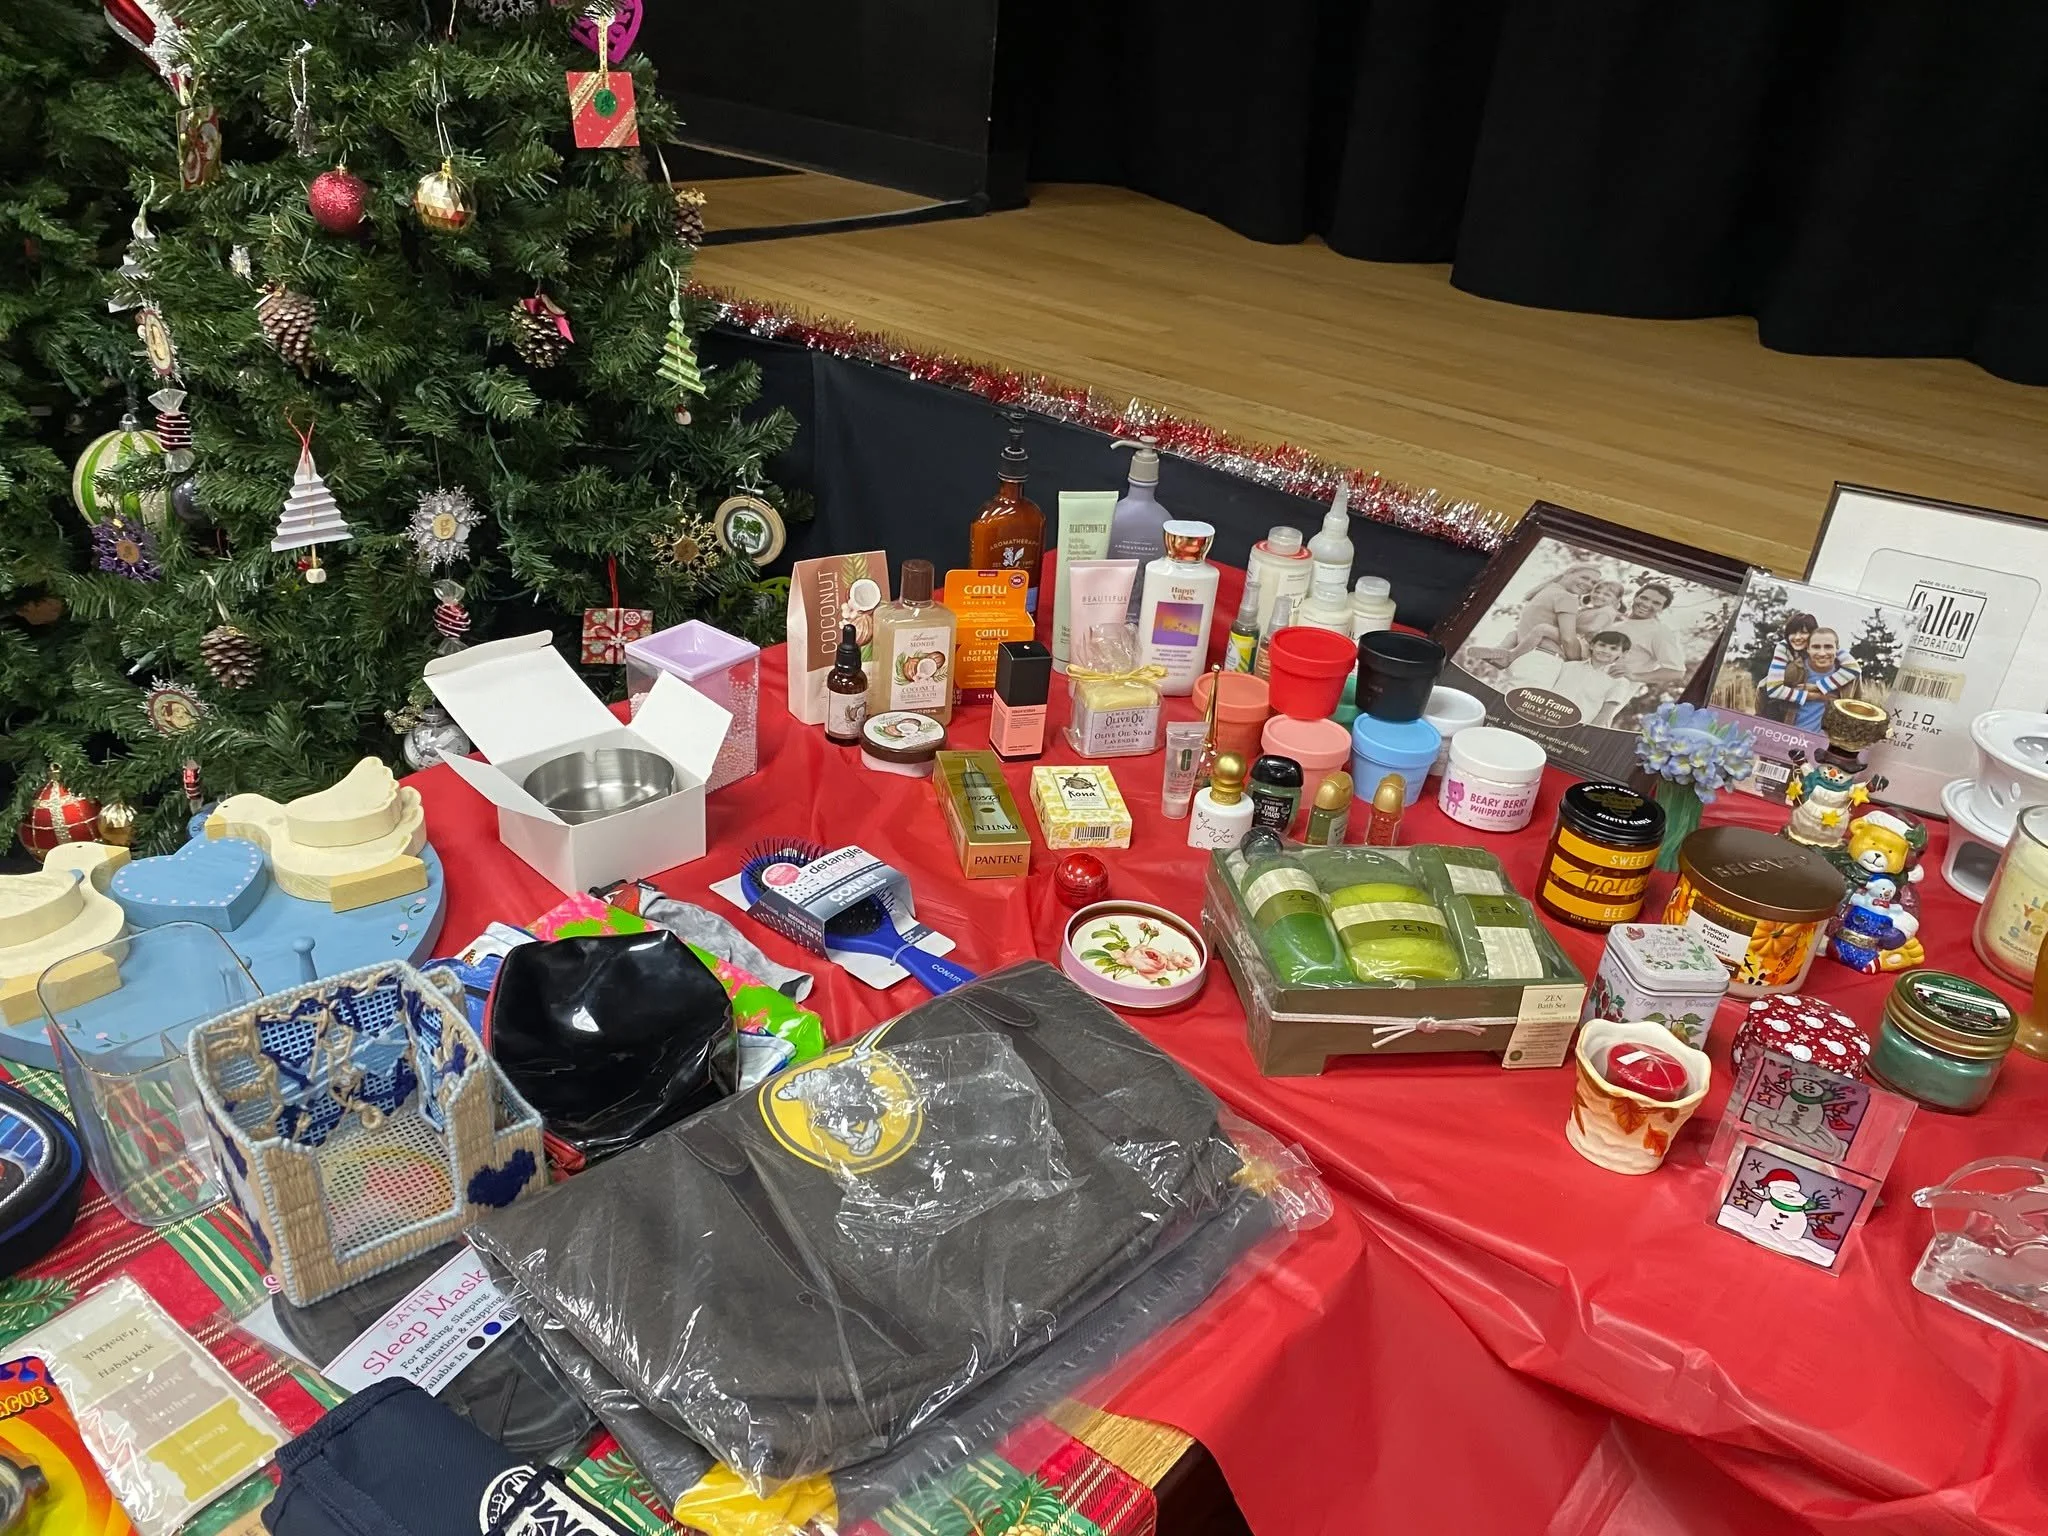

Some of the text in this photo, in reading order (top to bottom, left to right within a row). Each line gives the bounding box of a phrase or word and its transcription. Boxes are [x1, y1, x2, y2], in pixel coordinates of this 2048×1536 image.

[1069, 524, 1107, 533] BEAUTYCOUNTER
[990, 539, 1039, 551] AROMATHERAPY
[963, 584, 1007, 595] cantu
[1171, 586, 1196, 596] Happy
[1172, 593, 1194, 601] Vibes
[818, 568, 838, 654] COCONUT
[975, 629, 1009, 637] cantu
[902, 685, 937, 693] COCONUT
[1520, 689, 1574, 715] Photo Frame
[1521, 701, 1536, 711] 8in
[1544, 709, 1562, 720] 10in
[1892, 708, 1935, 726] X 10
[1896, 720, 1943, 736] SIZE MAT
[1094, 732, 1116, 740] OLIVE
[1509, 722, 1539, 737] horizontal
[1546, 735, 1568, 746] vertical
[1568, 742, 1590, 755] display
[1753, 725, 1809, 748] megapix
[1905, 733, 1915, 742] 7
[1547, 745, 1563, 754] Pane
[1068, 790, 1096, 798] Kona
[1470, 793, 1528, 809] BEARY BERRY
[1470, 804, 1524, 817] WHIPPED SOAP
[809, 848, 863, 874] detangle
[974, 855, 1023, 865] PANTENE
[1610, 855, 1648, 866] SWEET
[829, 873, 880, 902] CONAIR
[1477, 905, 1515, 914] ZEN
[1603, 907, 1625, 918] BEE
[1390, 924, 1431, 934] ZEN
[1703, 923, 1730, 939] PUMPKIN
[1706, 930, 1728, 944] TONKA
[931, 963, 962, 984] CONAIR
[1544, 994, 1563, 1002] ZEN
[1635, 997, 1657, 1008] Joy
[386, 1288, 435, 1331] SATIN
[363, 1269, 488, 1376] Sleep Mask
[83, 1327, 141, 1362] Habakkuk
[409, 1334, 459, 1379] Meditation
[458, 1326, 468, 1335] &
[98, 1344, 155, 1379] Habakkuk
[400, 1353, 419, 1371] For
[424, 1351, 468, 1392] vailable In
